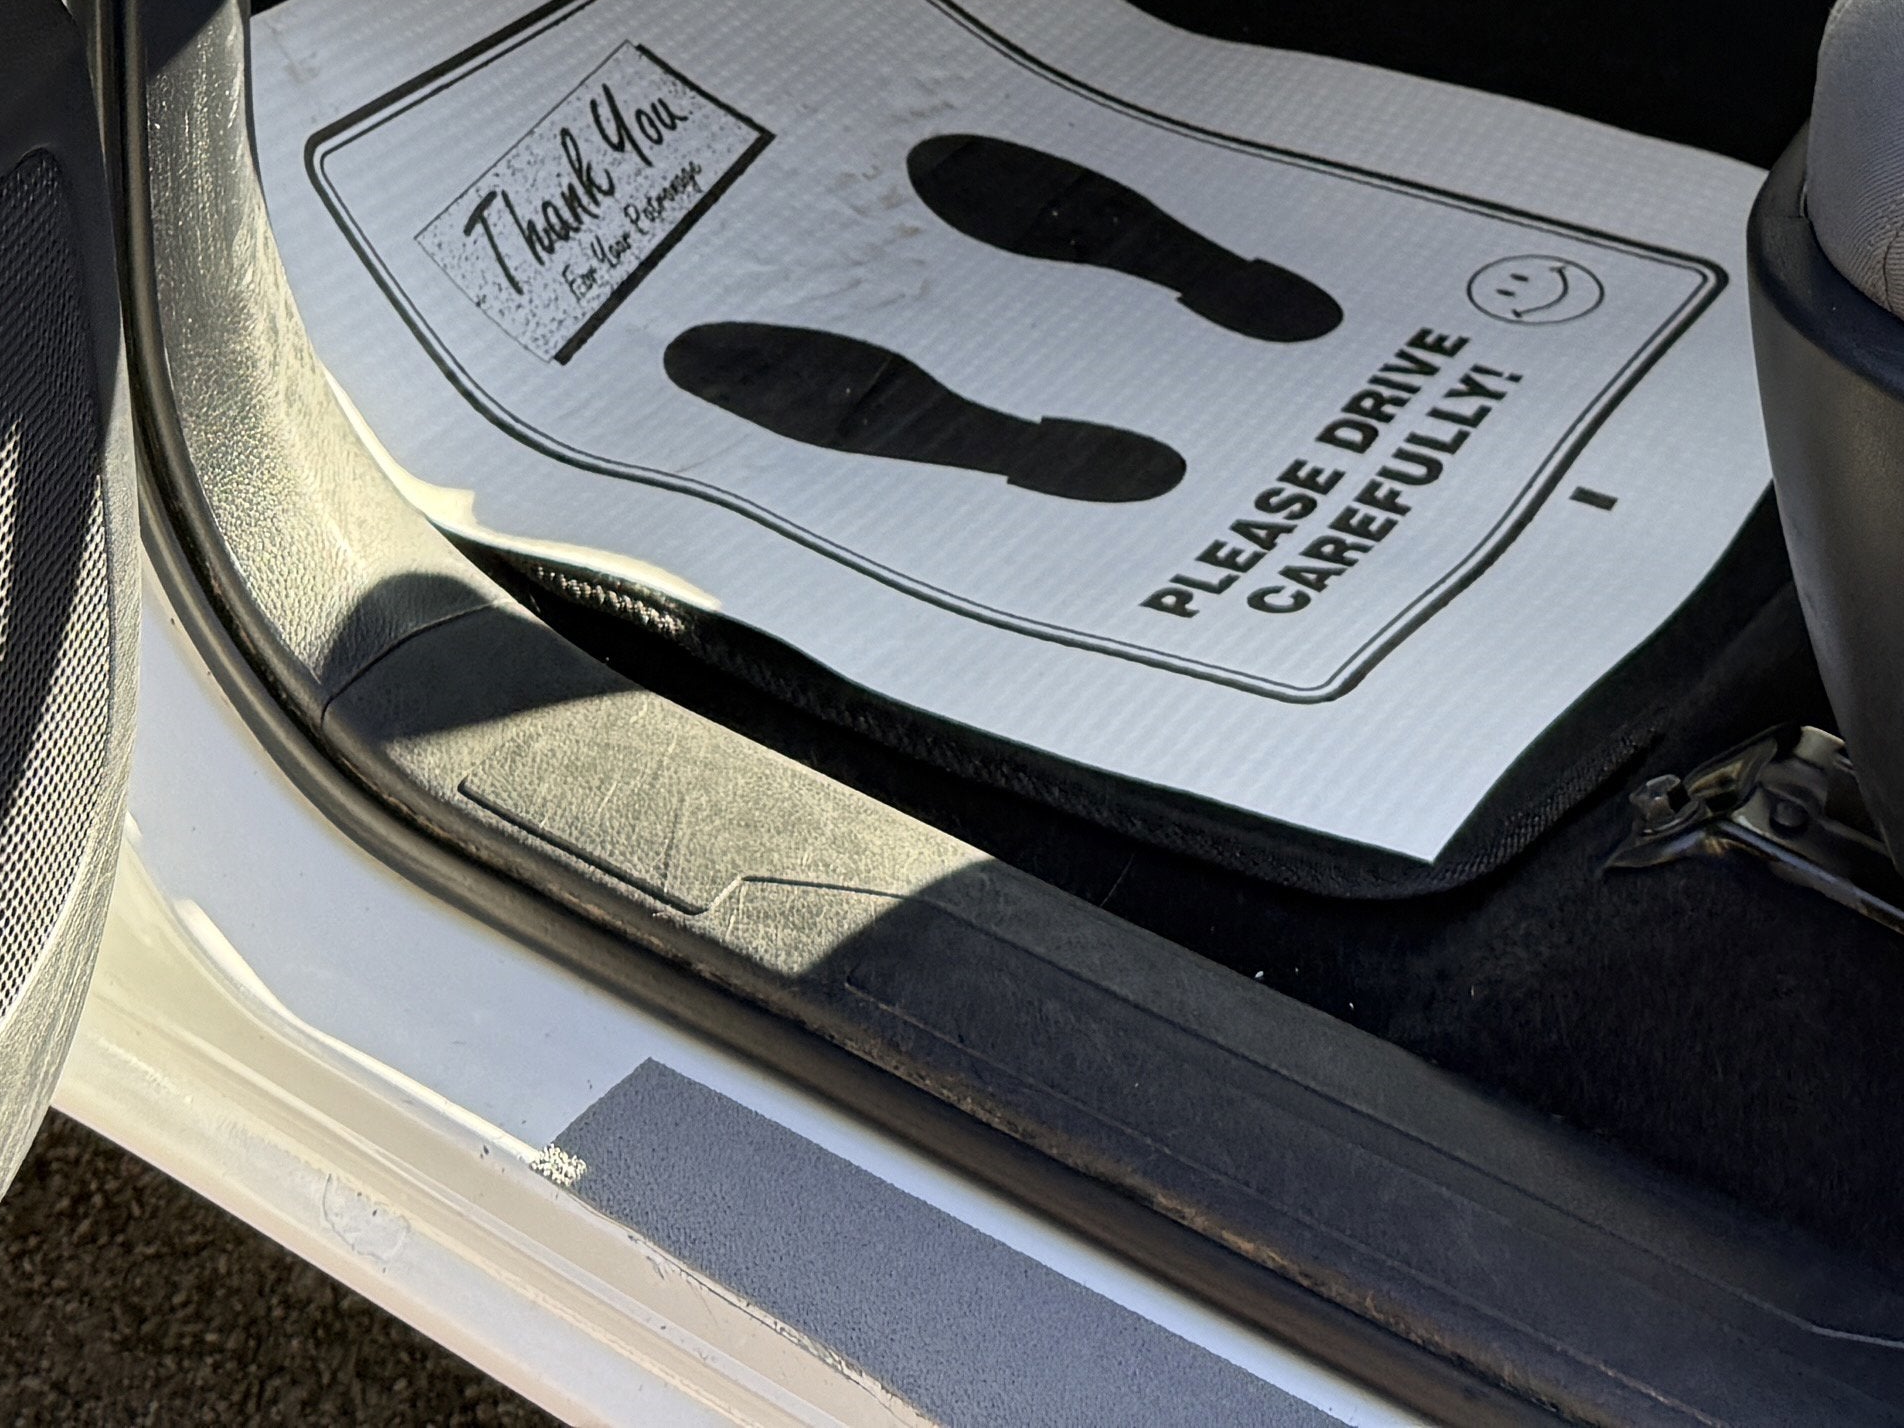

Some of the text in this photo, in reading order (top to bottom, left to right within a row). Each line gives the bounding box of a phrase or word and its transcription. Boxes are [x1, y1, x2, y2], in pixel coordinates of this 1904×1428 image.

[462, 82, 689, 296] Thank You
[1138, 326, 1471, 618] PLEASE DRIVE
[1246, 363, 1524, 614] CAREFULLY!
